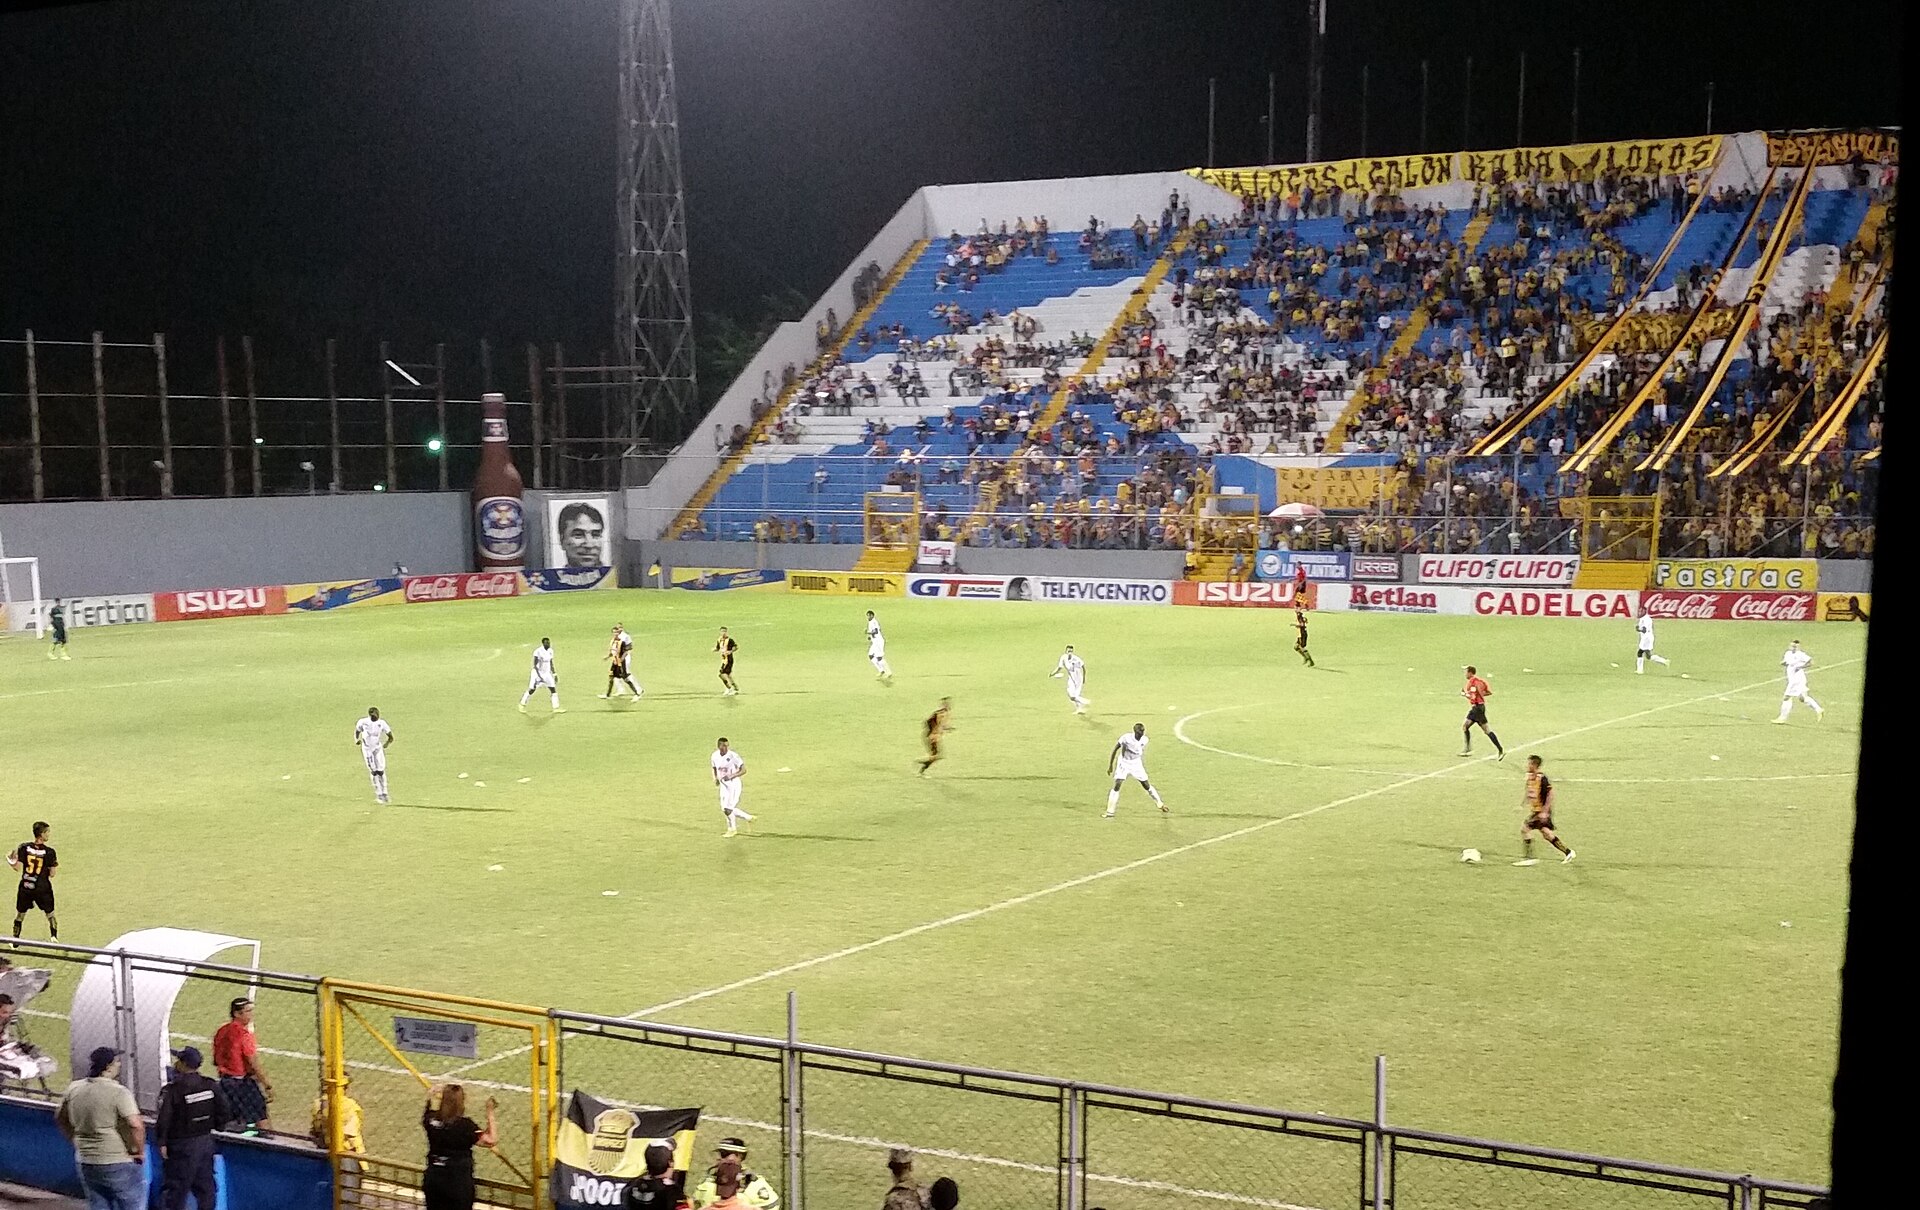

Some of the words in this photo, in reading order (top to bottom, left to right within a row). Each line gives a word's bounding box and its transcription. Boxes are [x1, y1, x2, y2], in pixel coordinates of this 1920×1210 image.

[1601, 137, 1713, 173] LOCOS
[1656, 562, 1804, 587] Fastrac
[176, 588, 267, 613] ISUZU
[1041, 581, 1167, 601] TELEVICENTRO
[1198, 582, 1295, 602] ISUZU
[1349, 583, 1437, 608] Retlan
[1475, 591, 1631, 617] CADELGA
[25, 854, 44, 875] 57
